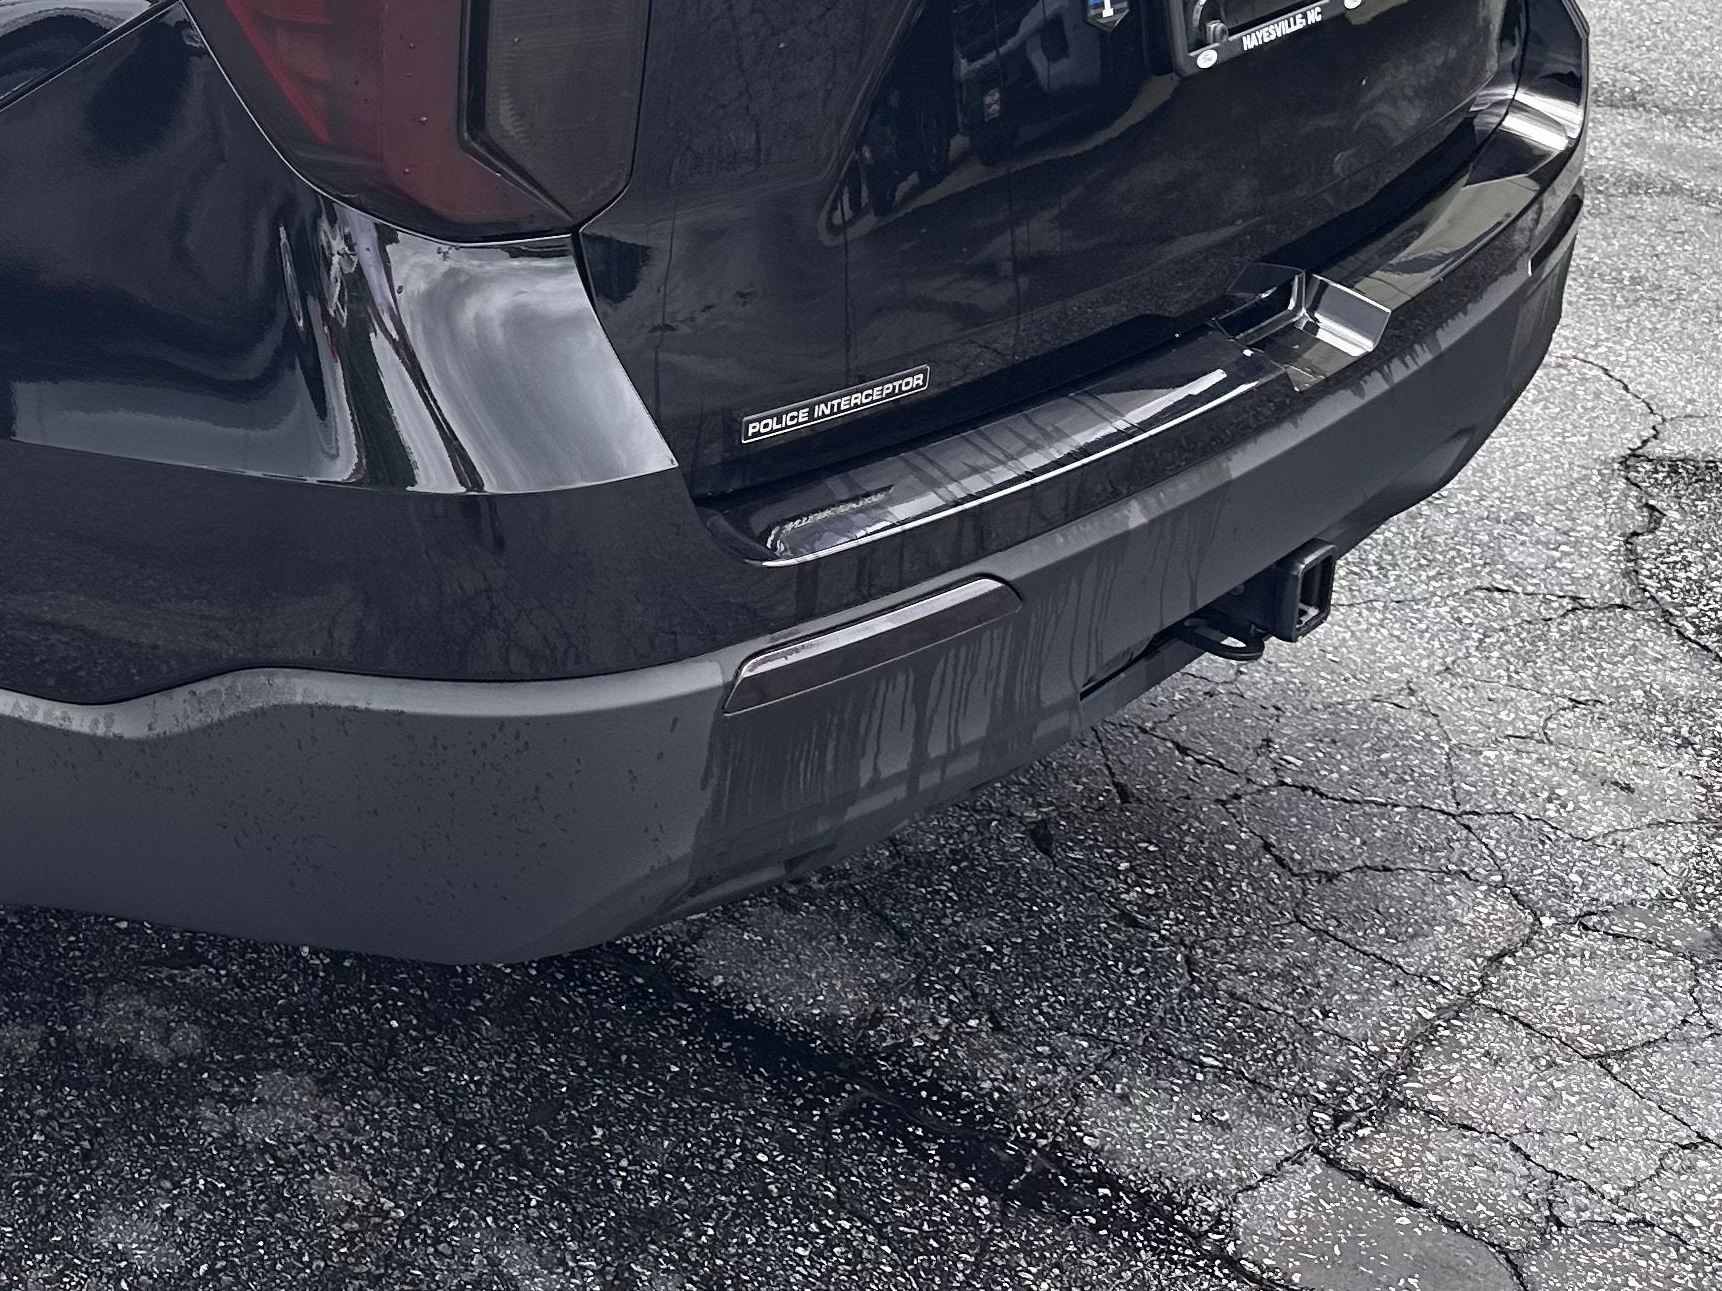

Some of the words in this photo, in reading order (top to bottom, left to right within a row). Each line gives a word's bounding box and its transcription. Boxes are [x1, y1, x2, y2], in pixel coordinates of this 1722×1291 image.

[1307, 6, 1323, 26] NC
[747, 408, 809, 437] POLICE
[814, 373, 925, 419] INTERCEPTOR
